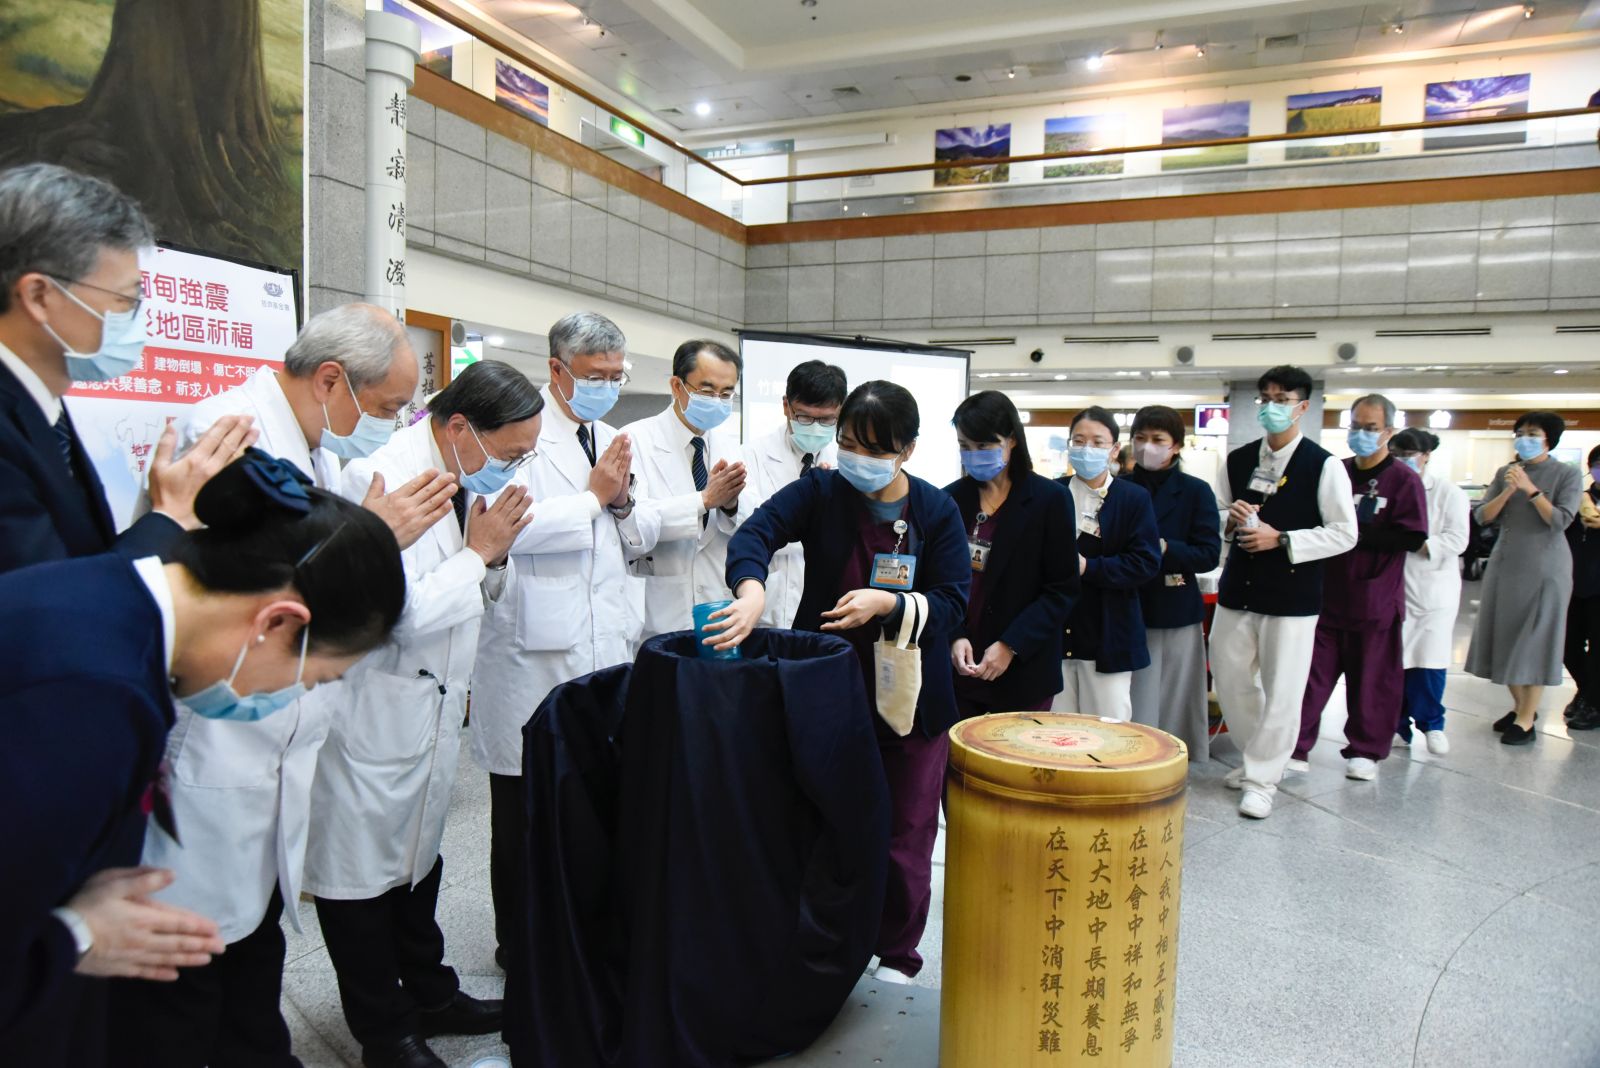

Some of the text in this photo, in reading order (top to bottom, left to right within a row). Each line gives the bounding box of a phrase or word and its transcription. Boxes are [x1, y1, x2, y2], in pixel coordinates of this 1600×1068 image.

[146, 308, 253, 349] 地區祈福
[1120, 826, 1148, 1053] 在社會中祥和無爭
